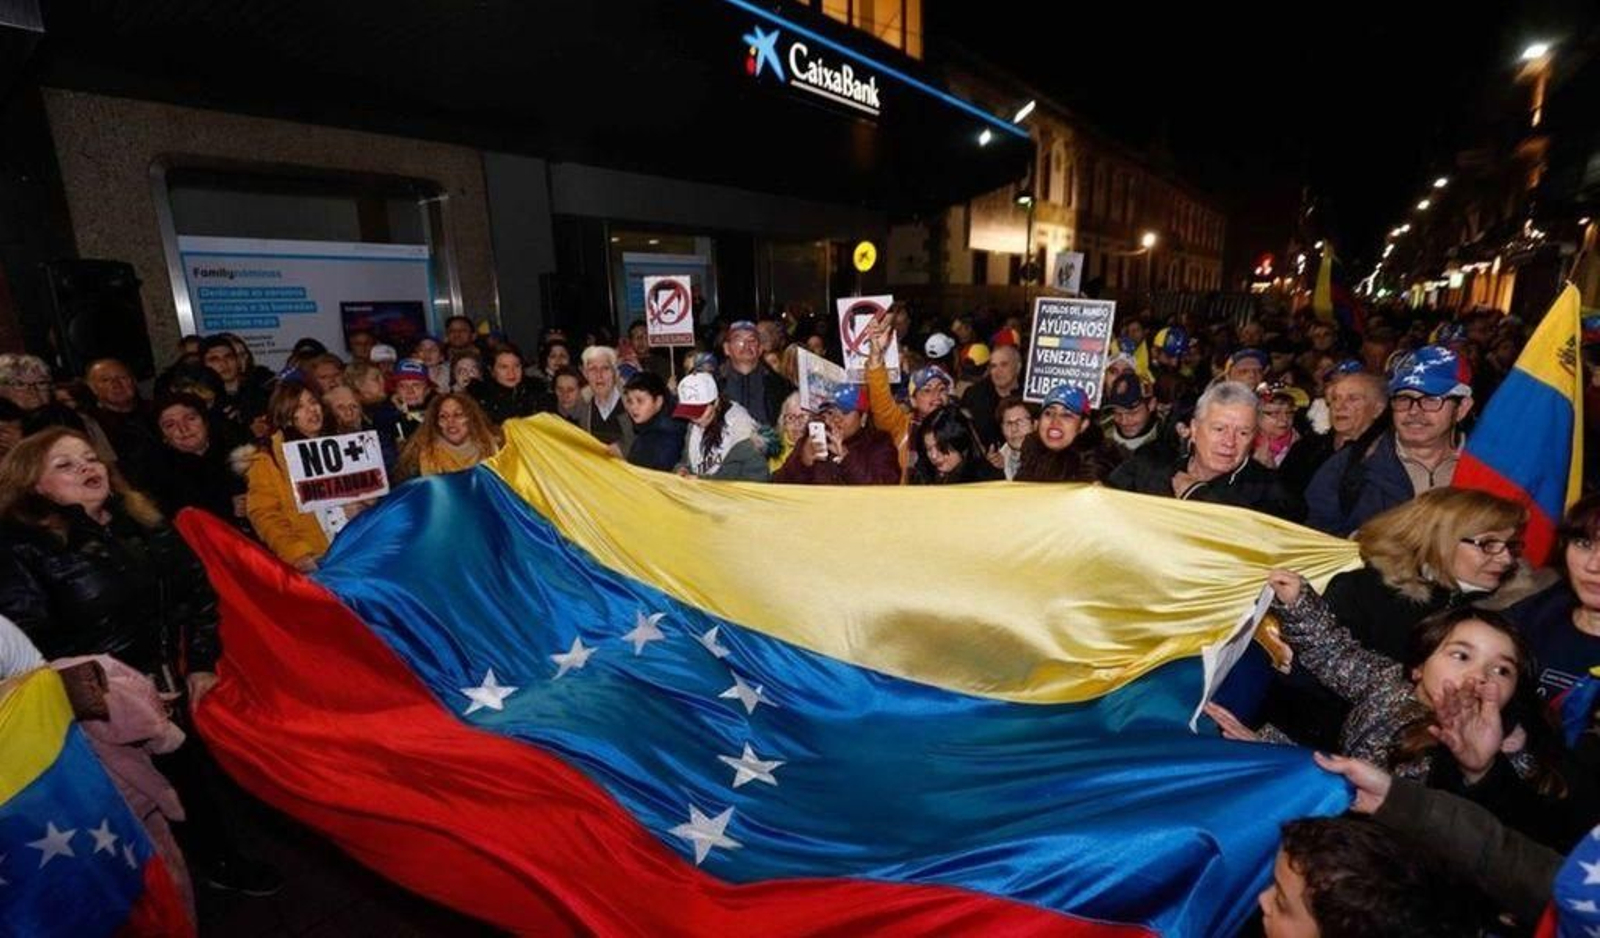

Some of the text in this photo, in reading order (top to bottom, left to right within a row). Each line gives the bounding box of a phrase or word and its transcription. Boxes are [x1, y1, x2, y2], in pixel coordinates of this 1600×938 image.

[789, 42, 880, 108] CaixaBank
[1041, 304, 1109, 319] PUEBLOS DEL MUNDO
[1038, 316, 1107, 339] AYÚDENOS!
[1036, 350, 1100, 369] VENEZUELA
